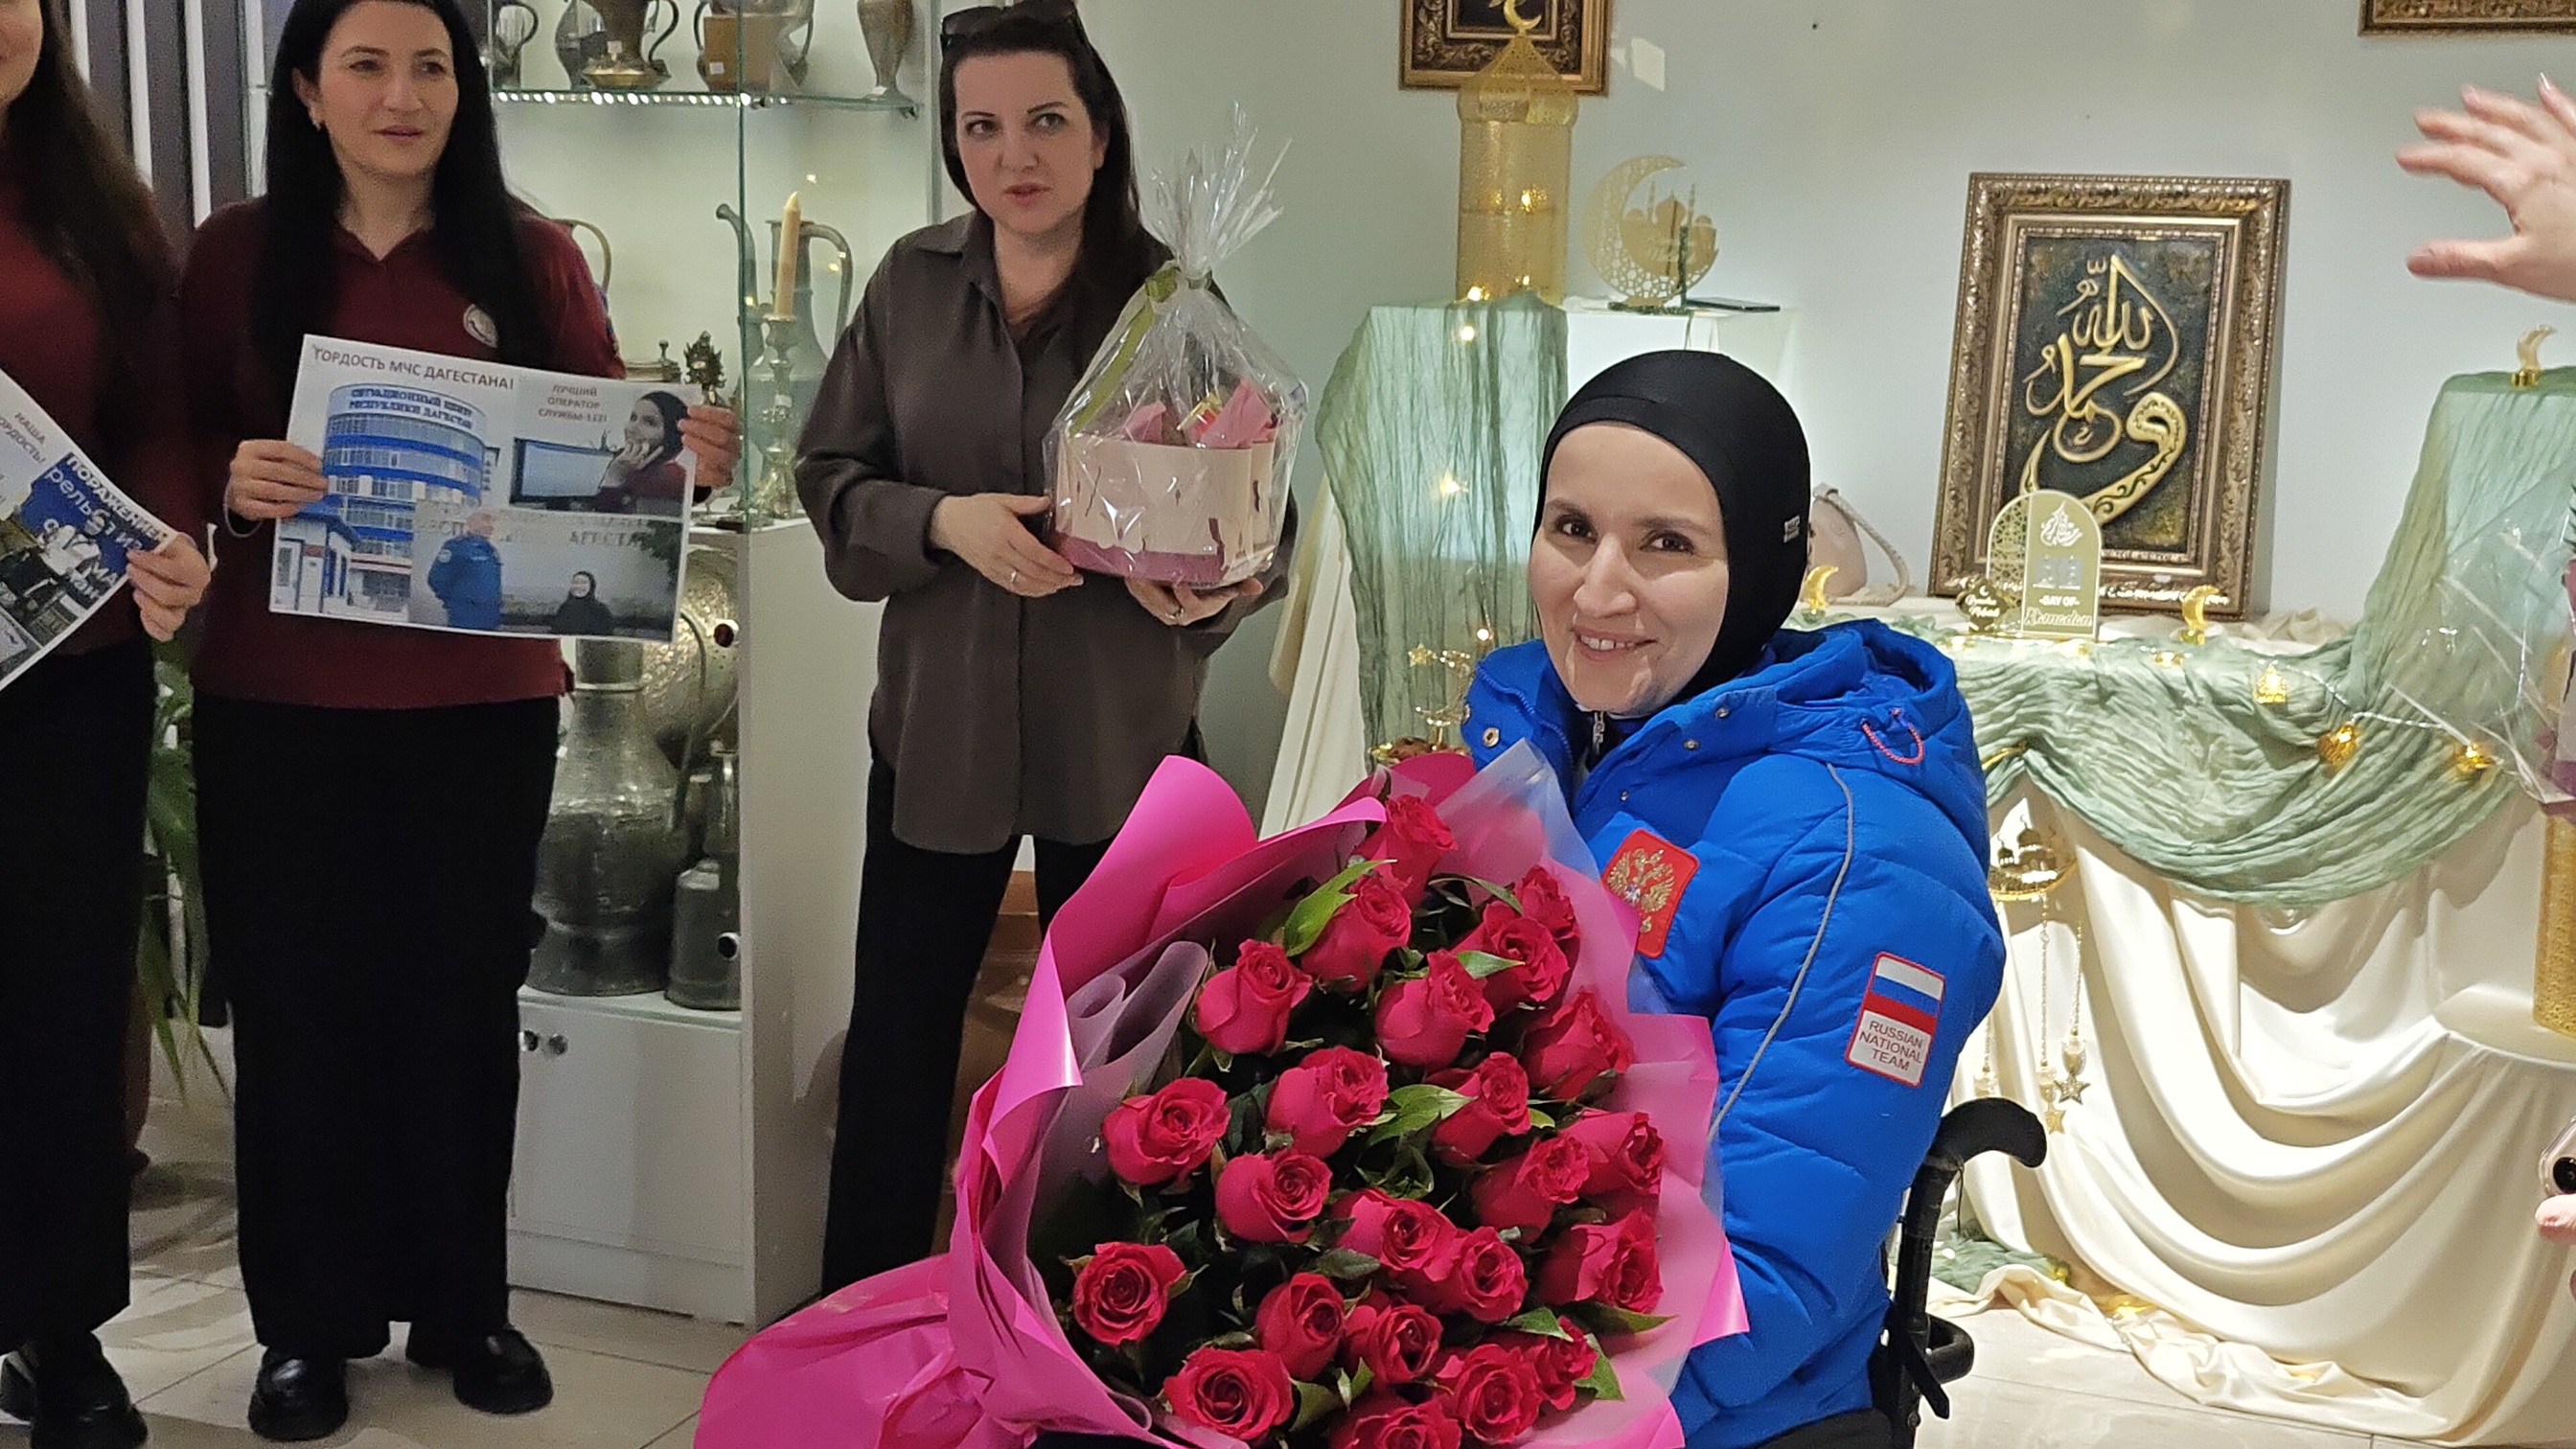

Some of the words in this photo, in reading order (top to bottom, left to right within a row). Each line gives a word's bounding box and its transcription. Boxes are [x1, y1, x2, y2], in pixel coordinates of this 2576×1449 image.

[312, 345, 385, 370] ГОРДОСТЬ
[389, 360, 422, 377] МЧС
[424, 366, 514, 390] ДАГЕСТАНА!
[547, 397, 600, 408] ОПЕРАТОР
[0, 417, 47, 465] ОРДОСТЬ!
[14, 412, 46, 445] НАША
[1859, 1030, 1922, 1064] NATIONAL
[1869, 1020, 1923, 1048] RUSSIAN
[1872, 1048, 1910, 1071] TEAM
